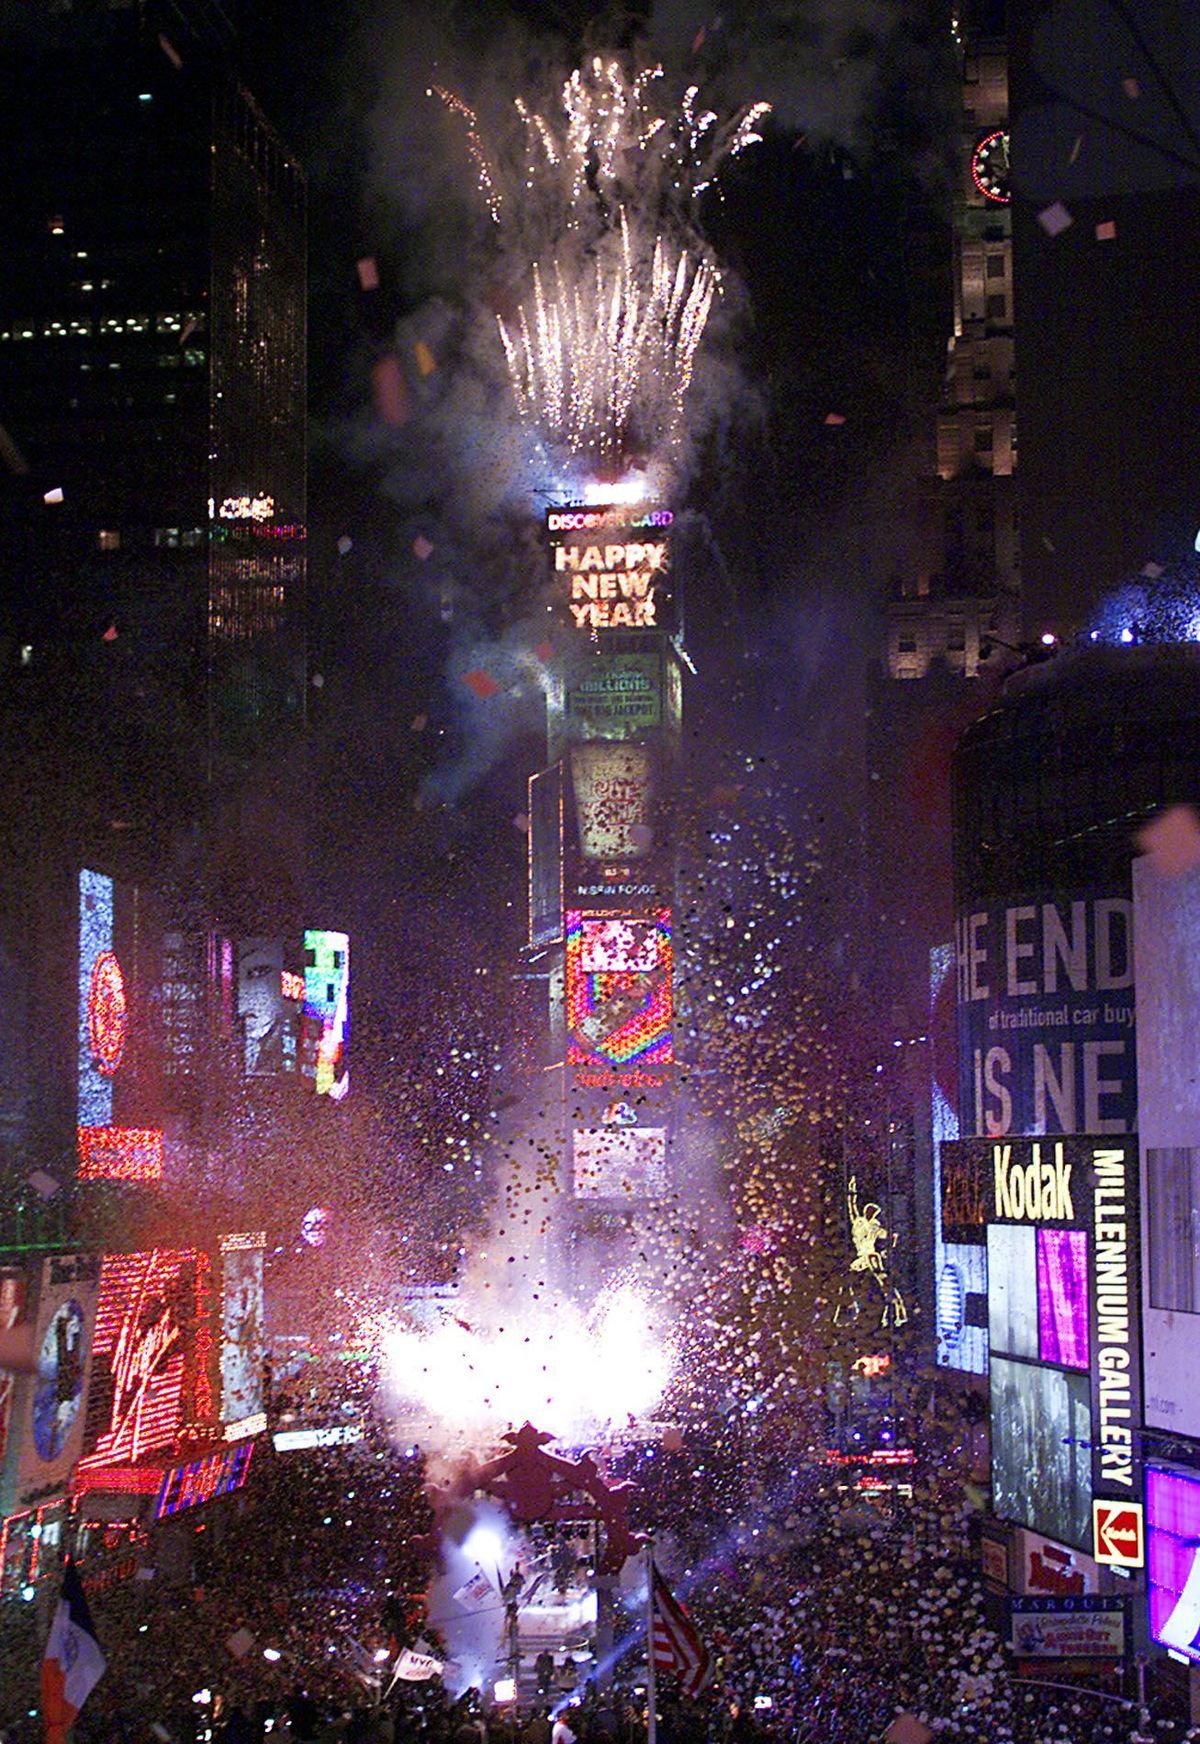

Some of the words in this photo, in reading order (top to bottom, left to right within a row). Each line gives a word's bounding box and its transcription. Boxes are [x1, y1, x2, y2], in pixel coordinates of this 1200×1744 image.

[548, 511, 625, 531] DISCOVER
[630, 510, 674, 527] CARD
[555, 543, 665, 571] HAPPY
[571, 572, 652, 599] NEW
[570, 601, 657, 628] YEAR
[1006, 898, 1135, 997] END
[1001, 1004, 1070, 1030] traditional
[1072, 1008, 1099, 1025] car
[974, 1046, 1013, 1137] IS
[993, 1142, 1075, 1221] Kodak
[1093, 1149, 1129, 1344] MILLENNIUM
[1098, 1346, 1133, 1487] GALLERY
